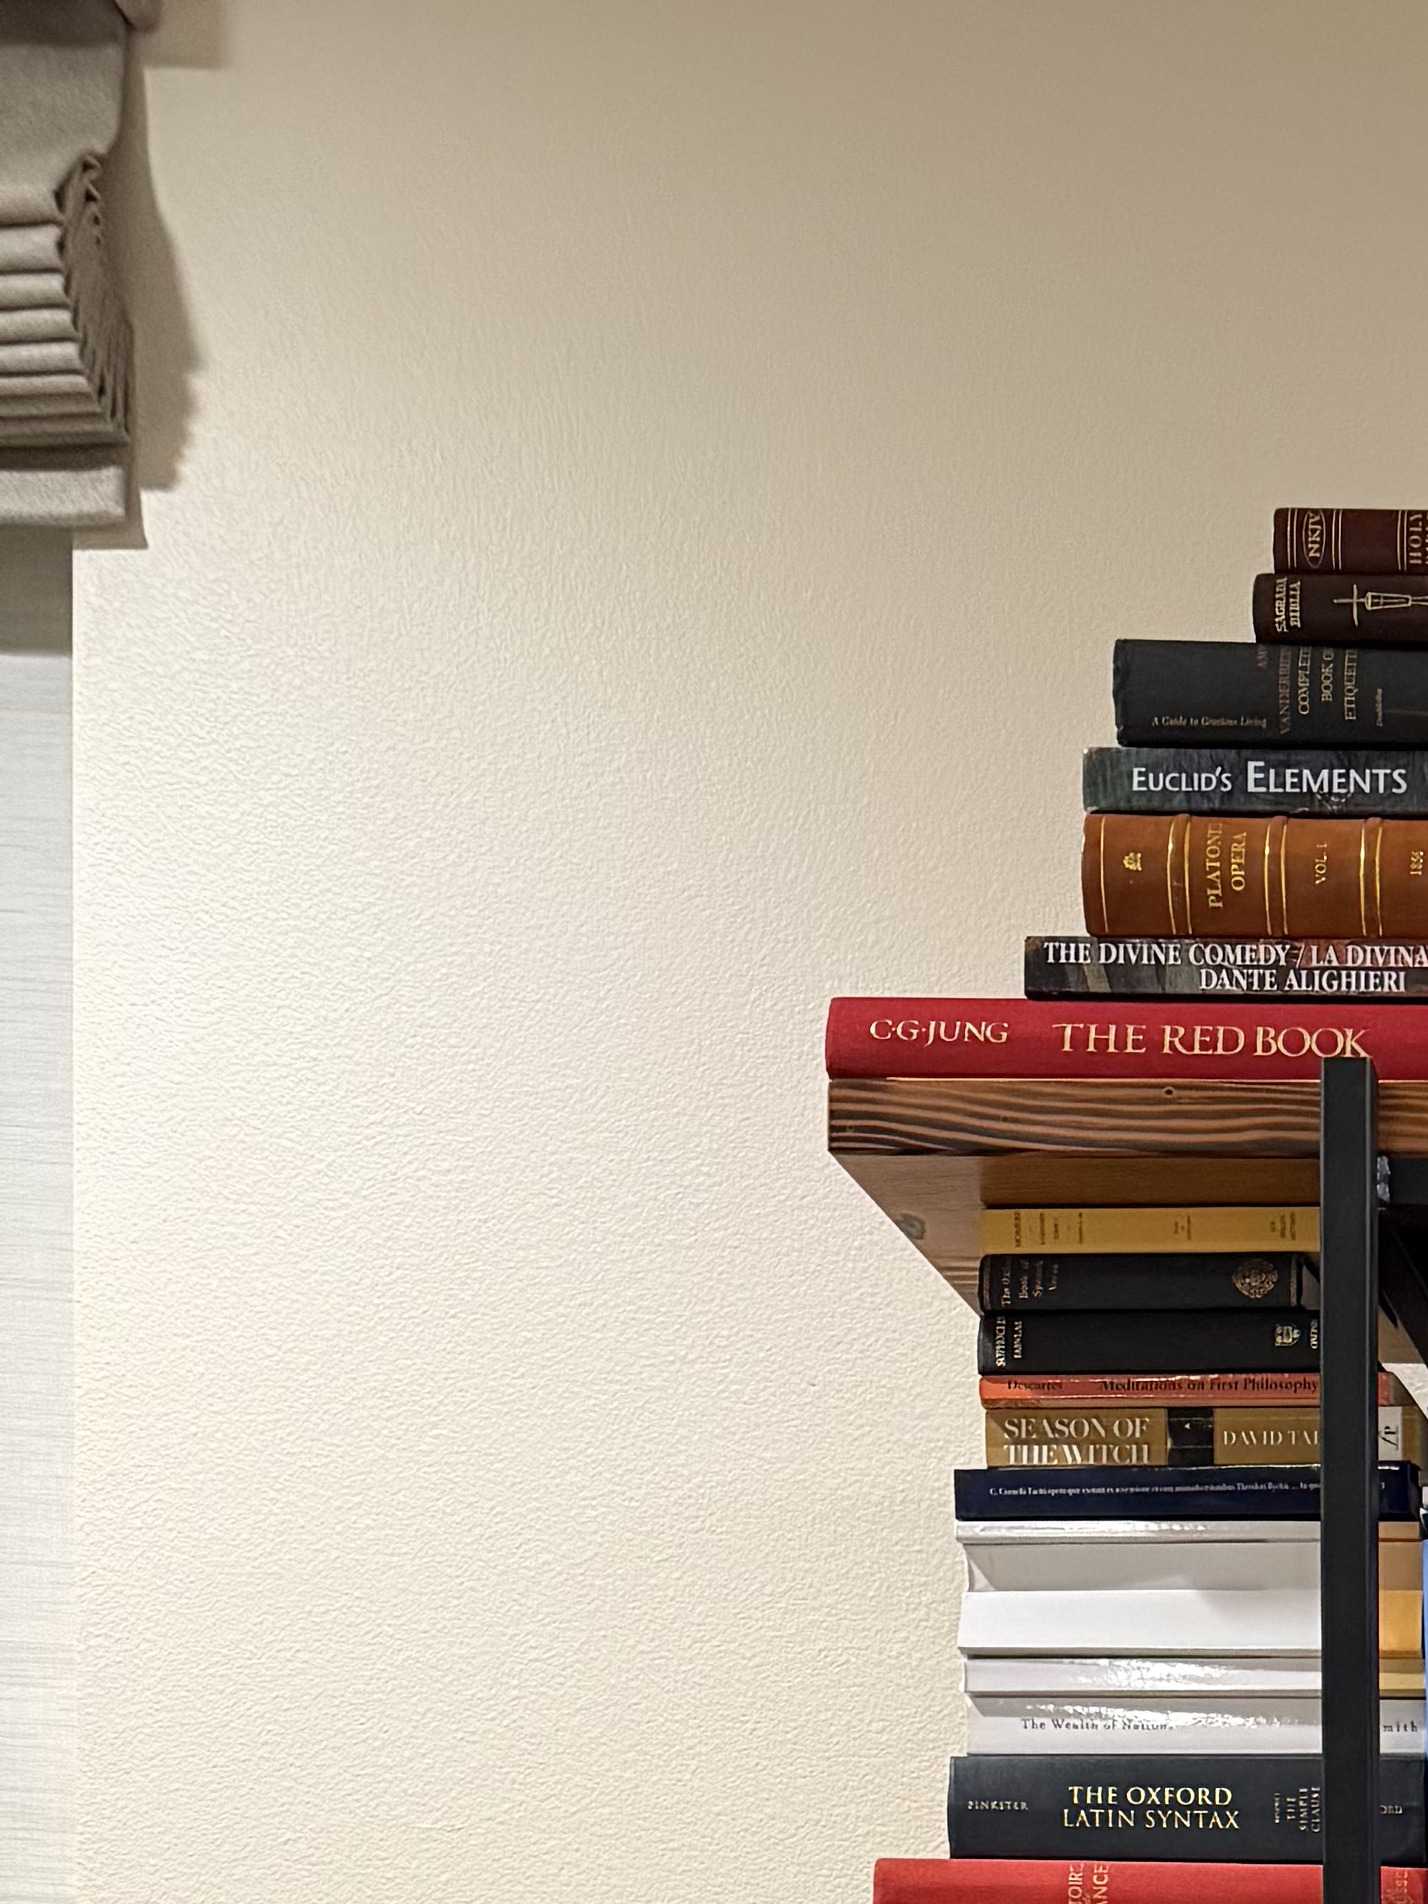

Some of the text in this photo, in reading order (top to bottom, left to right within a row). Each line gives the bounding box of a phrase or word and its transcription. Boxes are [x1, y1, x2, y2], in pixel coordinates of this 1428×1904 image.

[1246, 762, 1407, 794] ELEMENTS
[1044, 942, 1092, 964] THE
[1098, 942, 1182, 965] DIVINE
[1188, 943, 1291, 967] COMEDY
[1311, 944, 1344, 967] LA
[1200, 967, 1406, 992] DANTE ALIGHIERI
[1052, 1025, 1371, 1058] THE RED BOOK
[1003, 1417, 1149, 1443] SEASON OF
[1003, 1443, 1149, 1466] THE WITCH
[1069, 1786, 1233, 1805] THE OXFORD
[1063, 1810, 1240, 1831] LATIN SYNTAX
